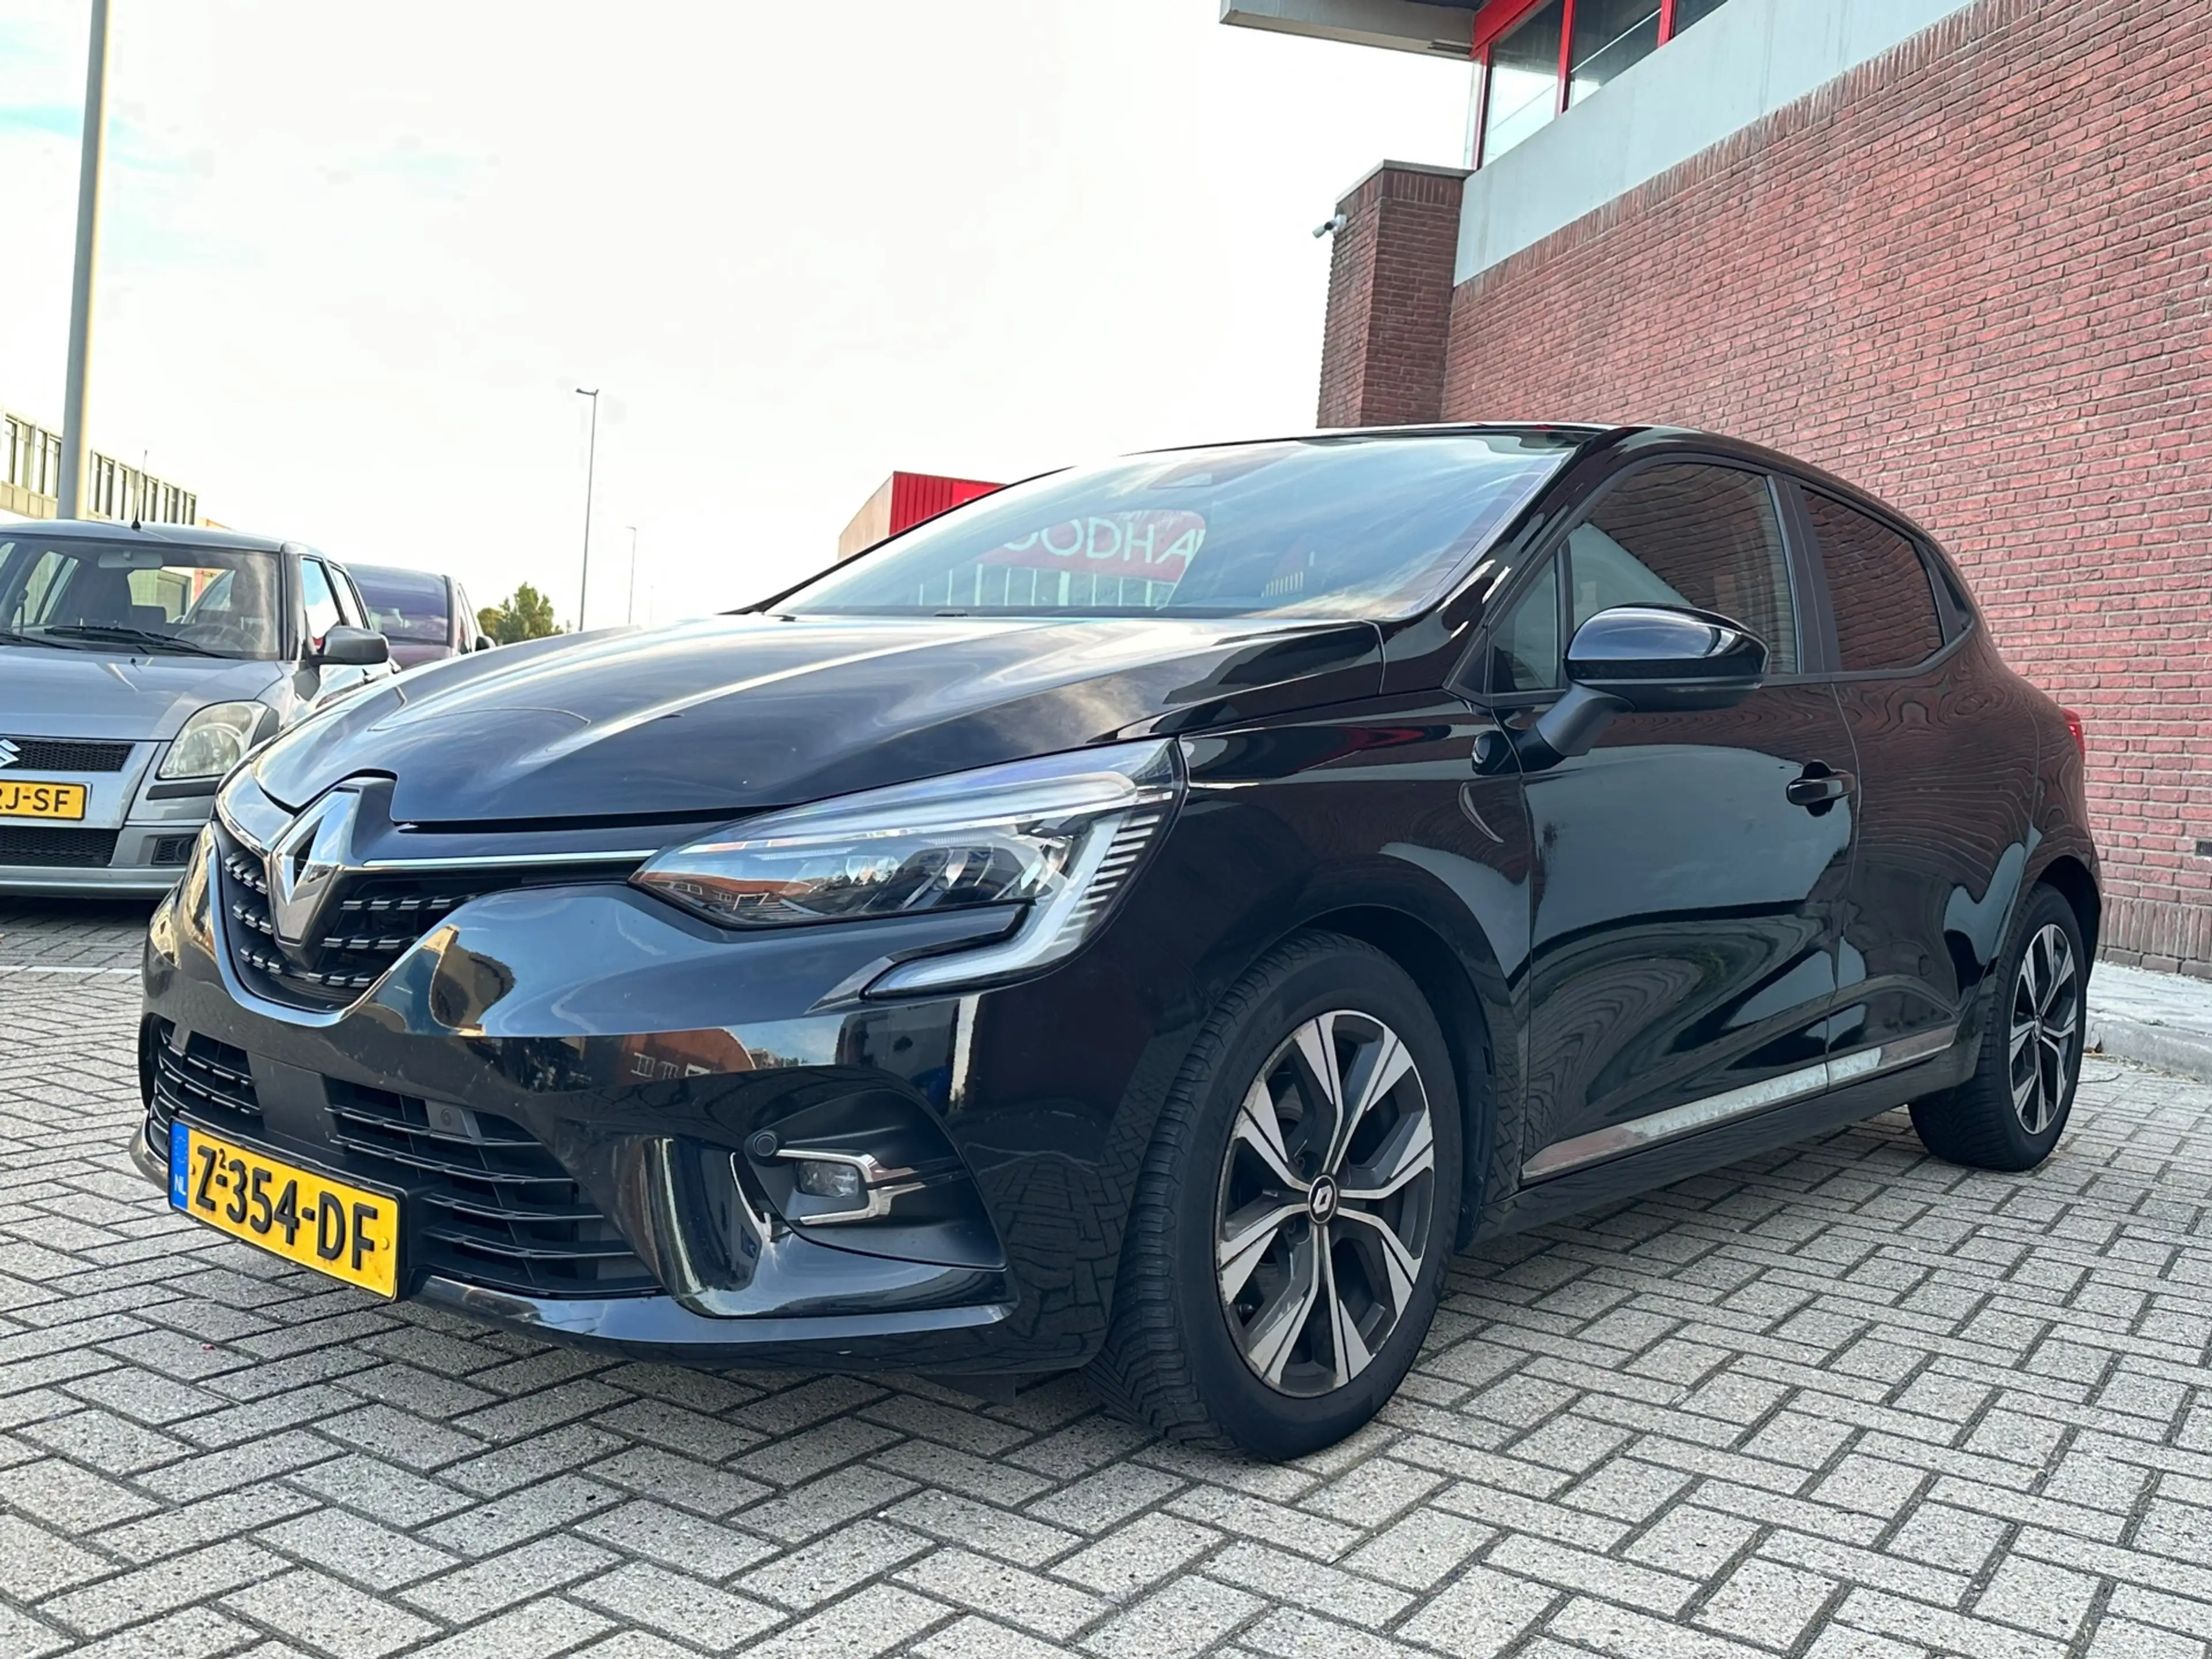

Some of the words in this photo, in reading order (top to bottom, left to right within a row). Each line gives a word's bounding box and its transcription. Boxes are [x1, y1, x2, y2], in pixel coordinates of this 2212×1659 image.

[0, 787, 70, 812] J-SF
[175, 1173, 187, 1196] NL
[195, 1145, 378, 1271] Z-354-DF
